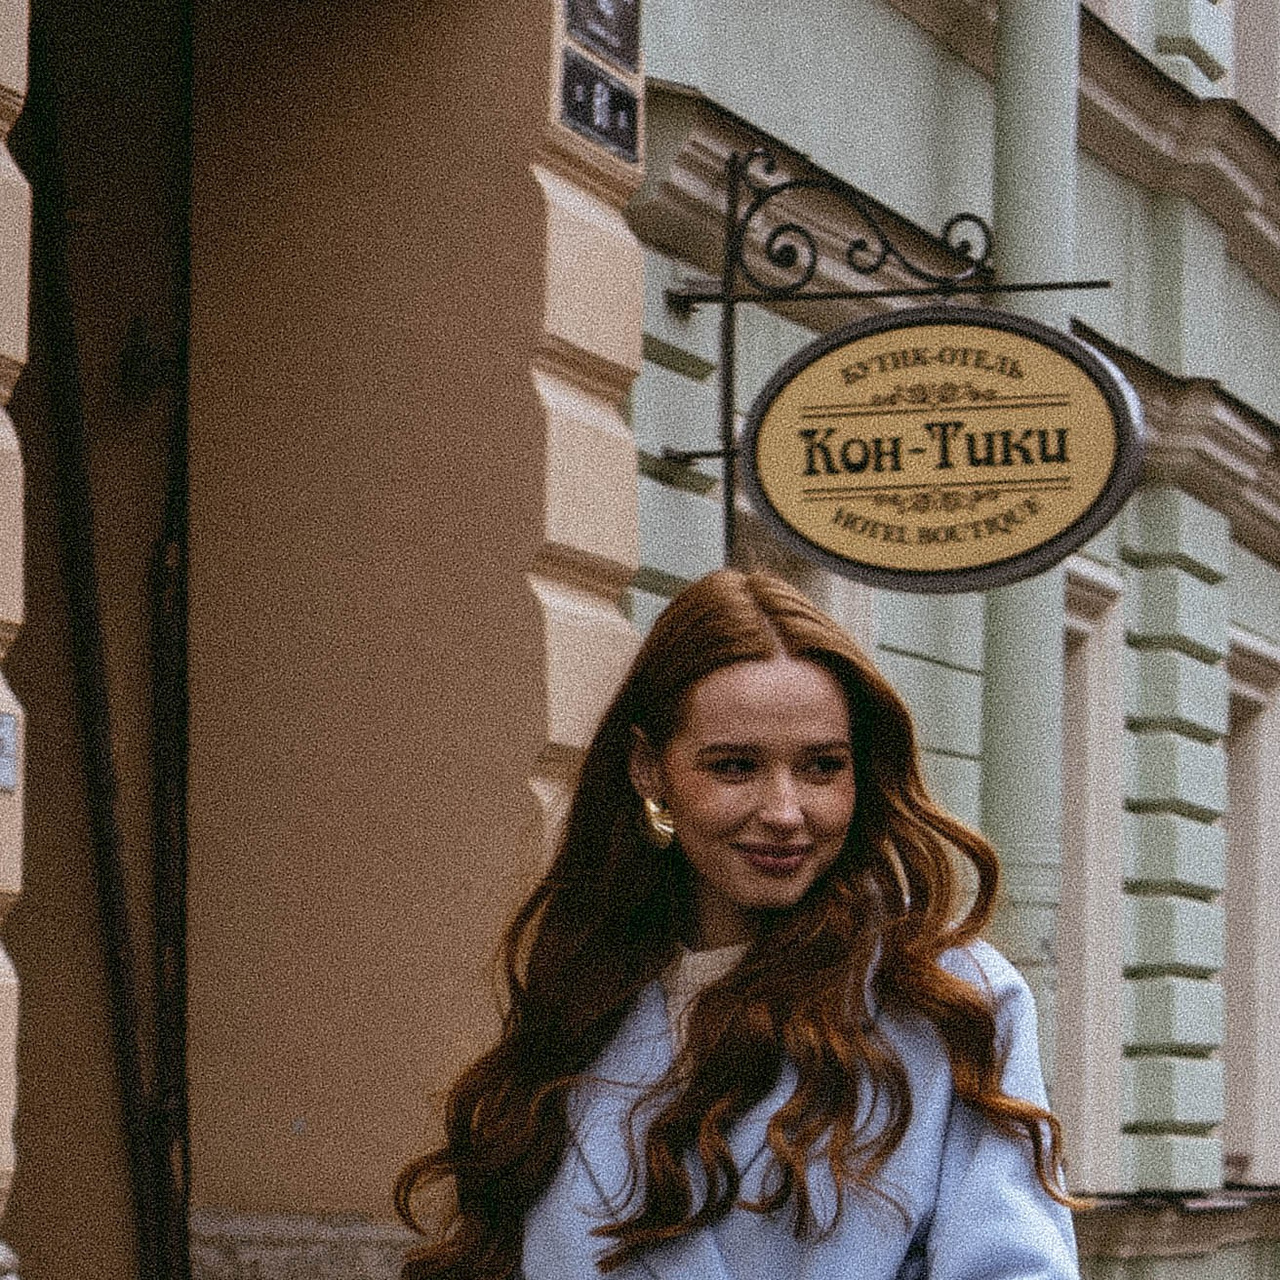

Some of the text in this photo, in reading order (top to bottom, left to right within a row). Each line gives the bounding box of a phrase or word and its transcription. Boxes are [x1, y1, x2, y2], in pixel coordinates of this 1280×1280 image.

[840, 347, 1024, 385] БУТИК-ОТЕЛЬ
[800, 421, 1071, 476] Кон-Тики
[832, 507, 908, 544] HOTEL
